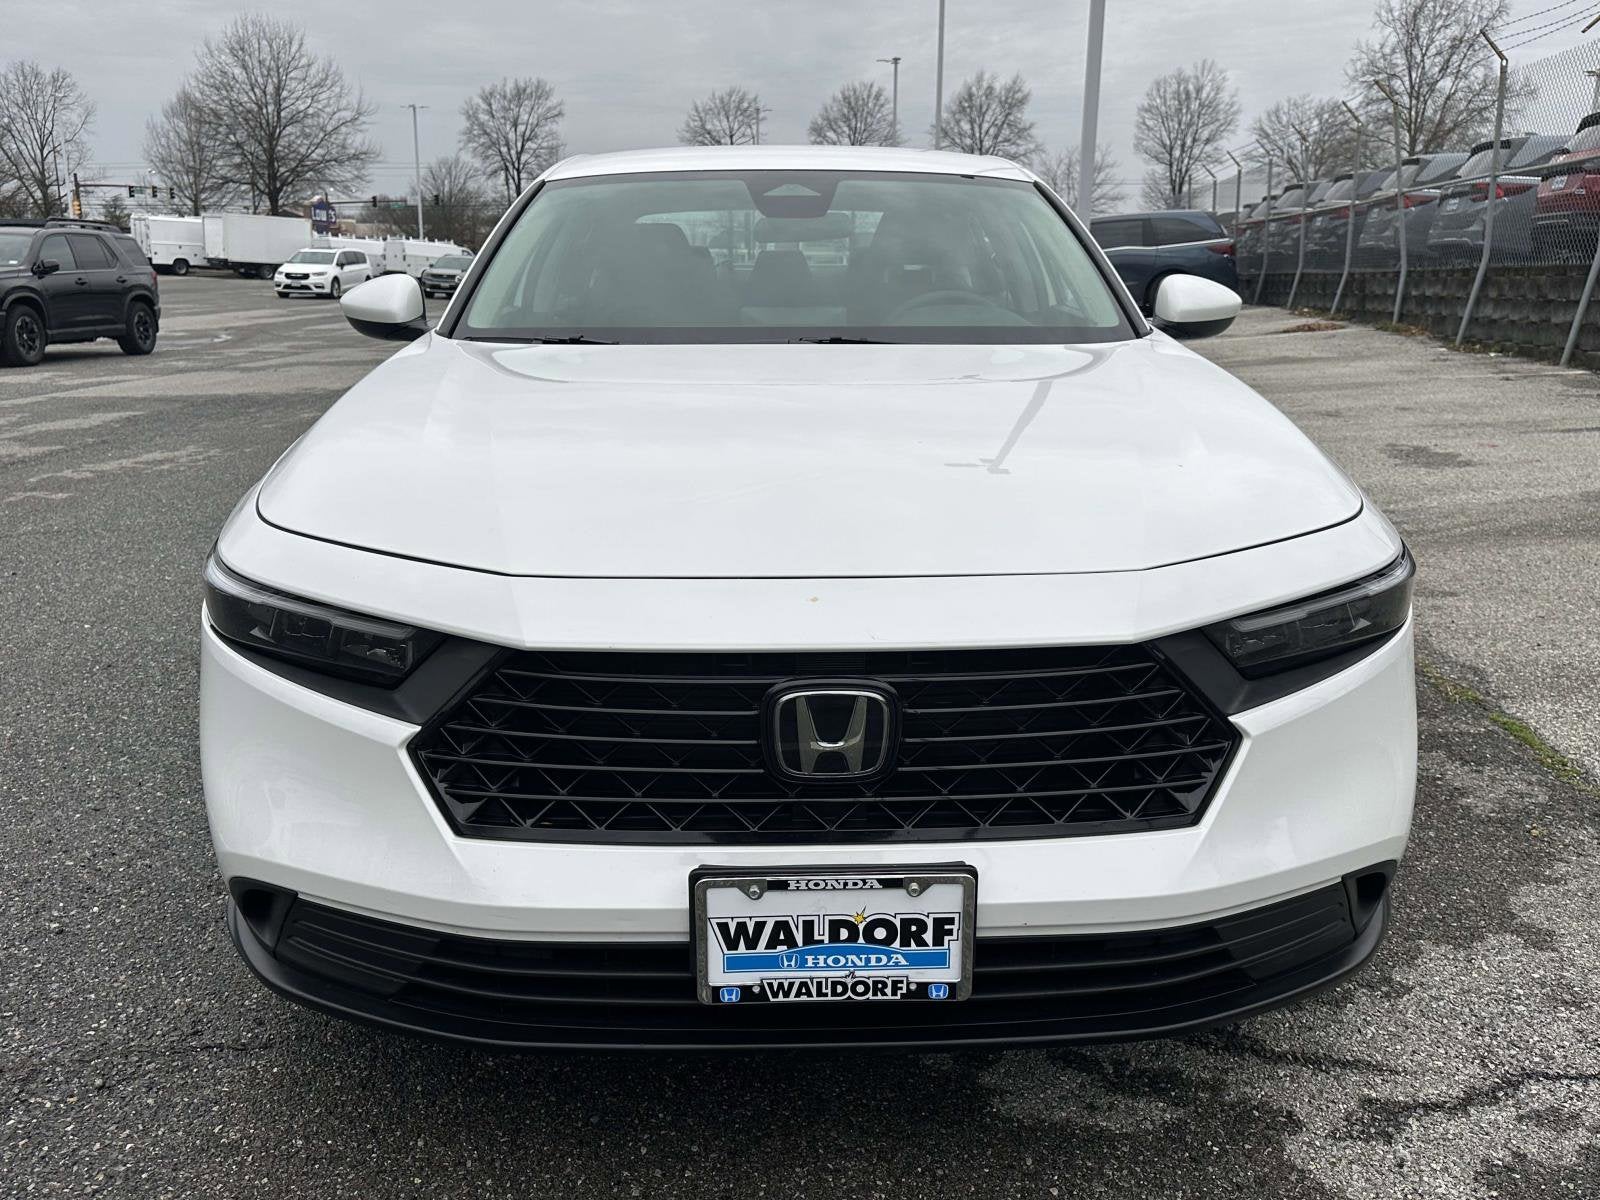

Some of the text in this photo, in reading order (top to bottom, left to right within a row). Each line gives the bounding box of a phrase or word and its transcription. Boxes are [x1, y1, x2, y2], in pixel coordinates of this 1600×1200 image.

[787, 879, 883, 890] HONDA
[715, 916, 956, 952] WALDORF
[804, 953, 910, 968] HONDA
[764, 978, 906, 1000] WALDORF
